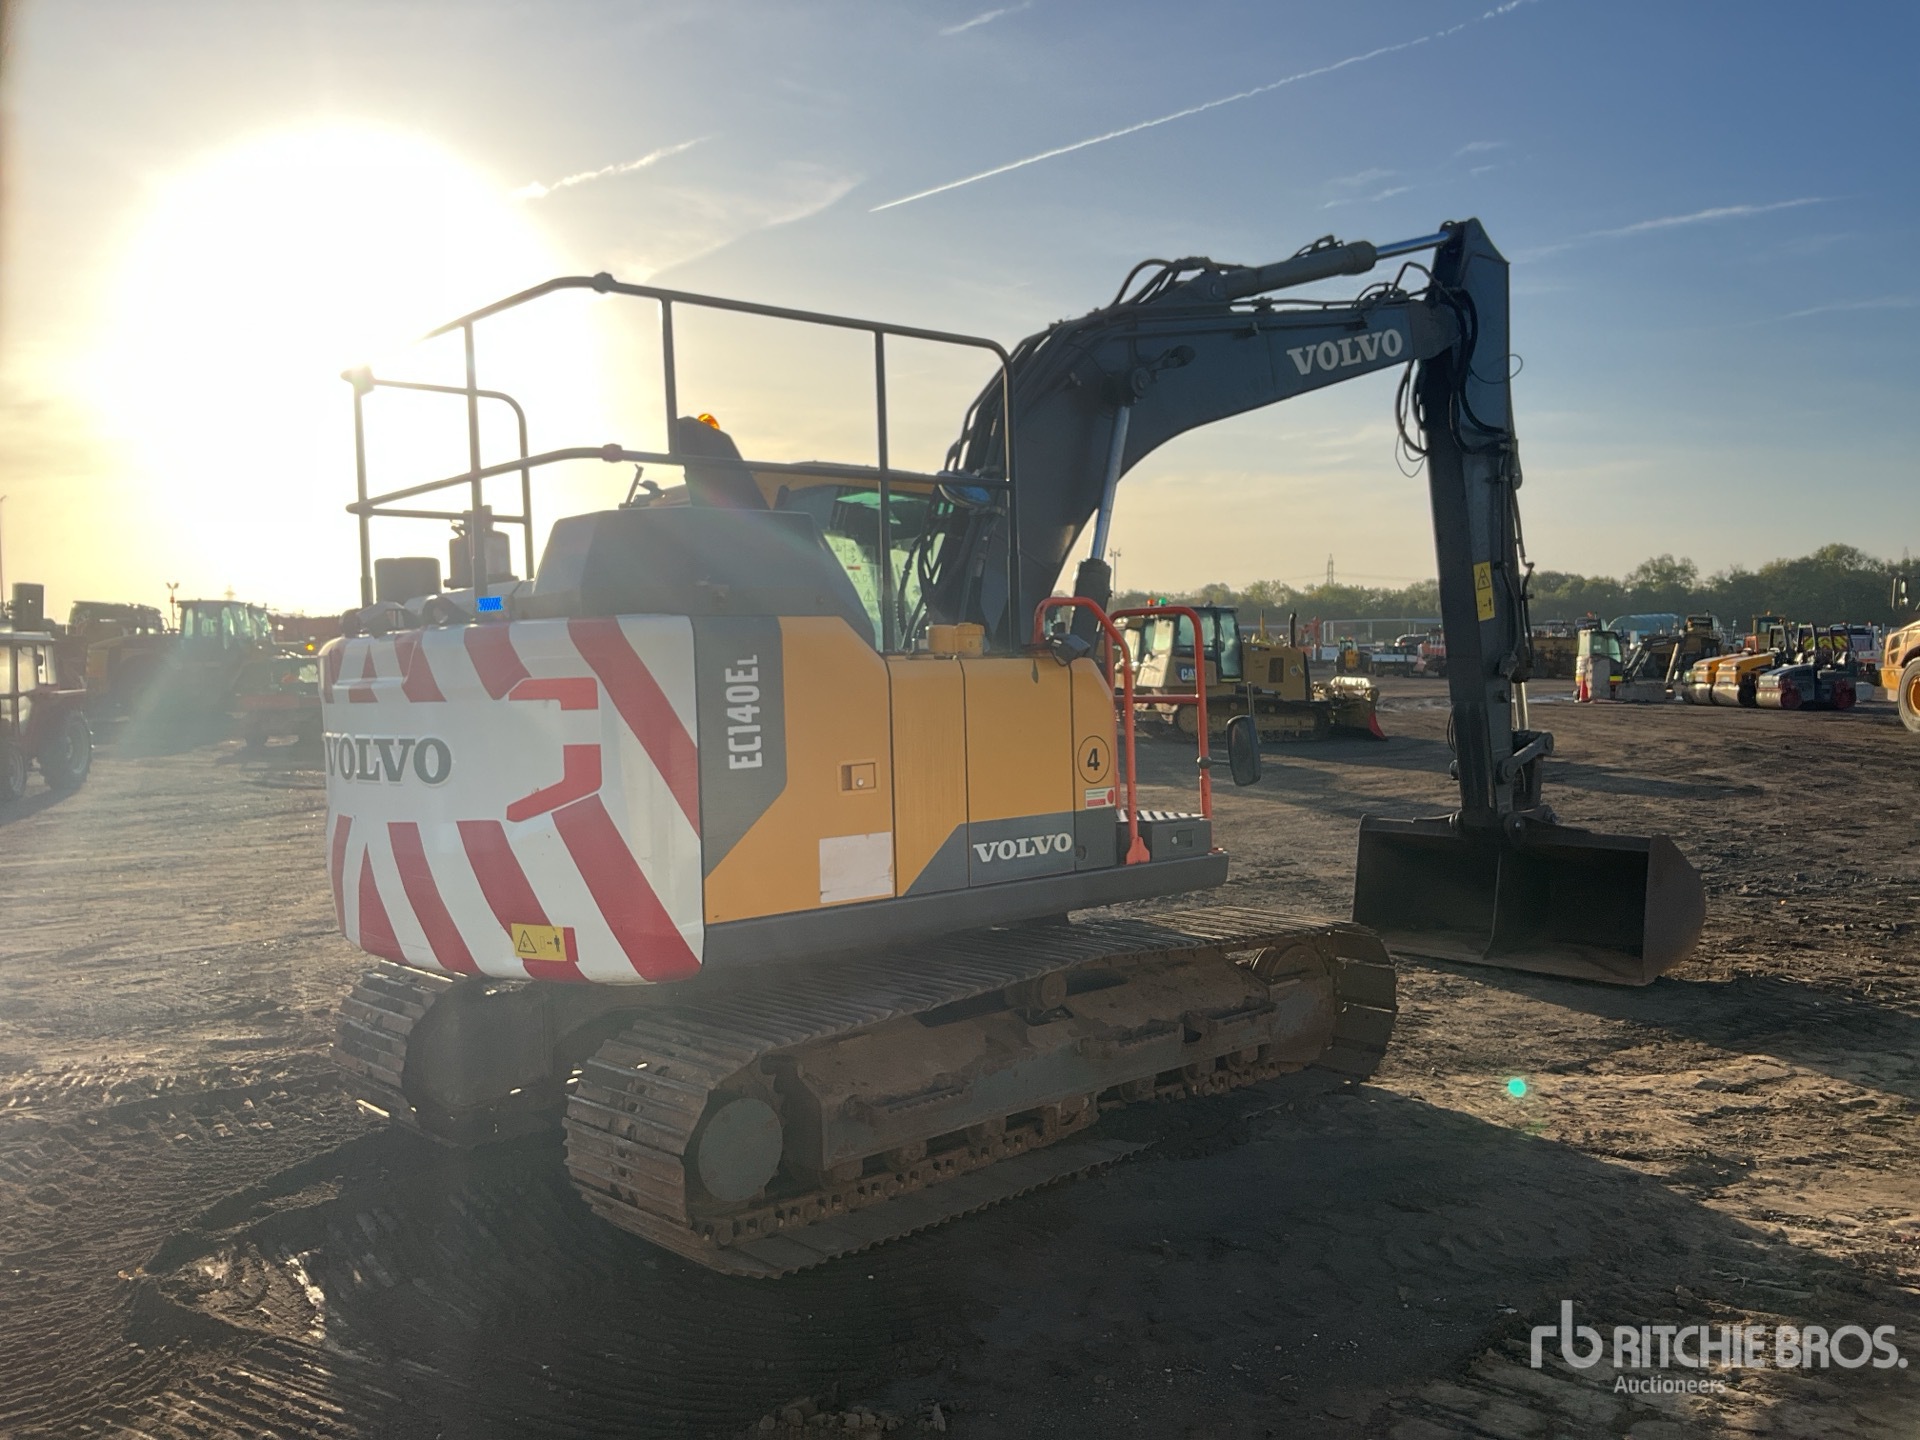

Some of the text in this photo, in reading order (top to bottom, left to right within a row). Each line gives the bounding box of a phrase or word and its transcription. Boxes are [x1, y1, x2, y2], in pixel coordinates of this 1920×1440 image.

[1286, 329, 1403, 375] VOLVO
[323, 733, 453, 785] VOLVO
[1087, 747, 1100, 771] 4
[972, 832, 1073, 863] VOLVO
